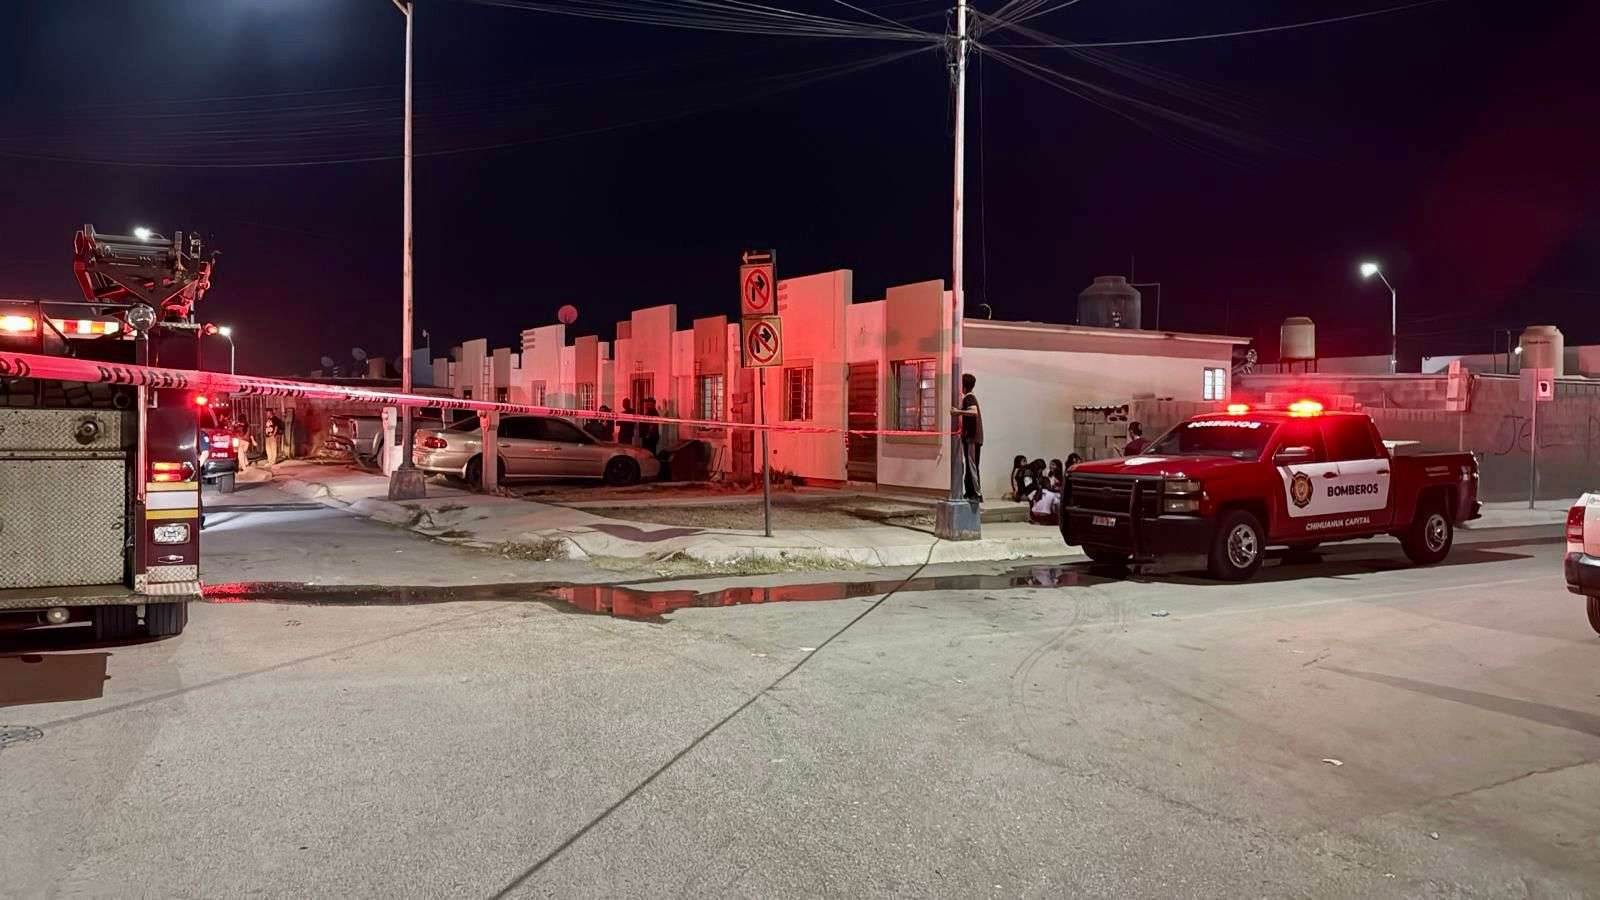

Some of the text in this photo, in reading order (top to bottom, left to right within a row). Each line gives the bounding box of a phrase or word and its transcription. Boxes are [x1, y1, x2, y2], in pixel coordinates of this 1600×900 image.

[1327, 483, 1379, 497] BOMBEROS
[1305, 516, 1371, 531] CHIHUAHUA CAPITAL
